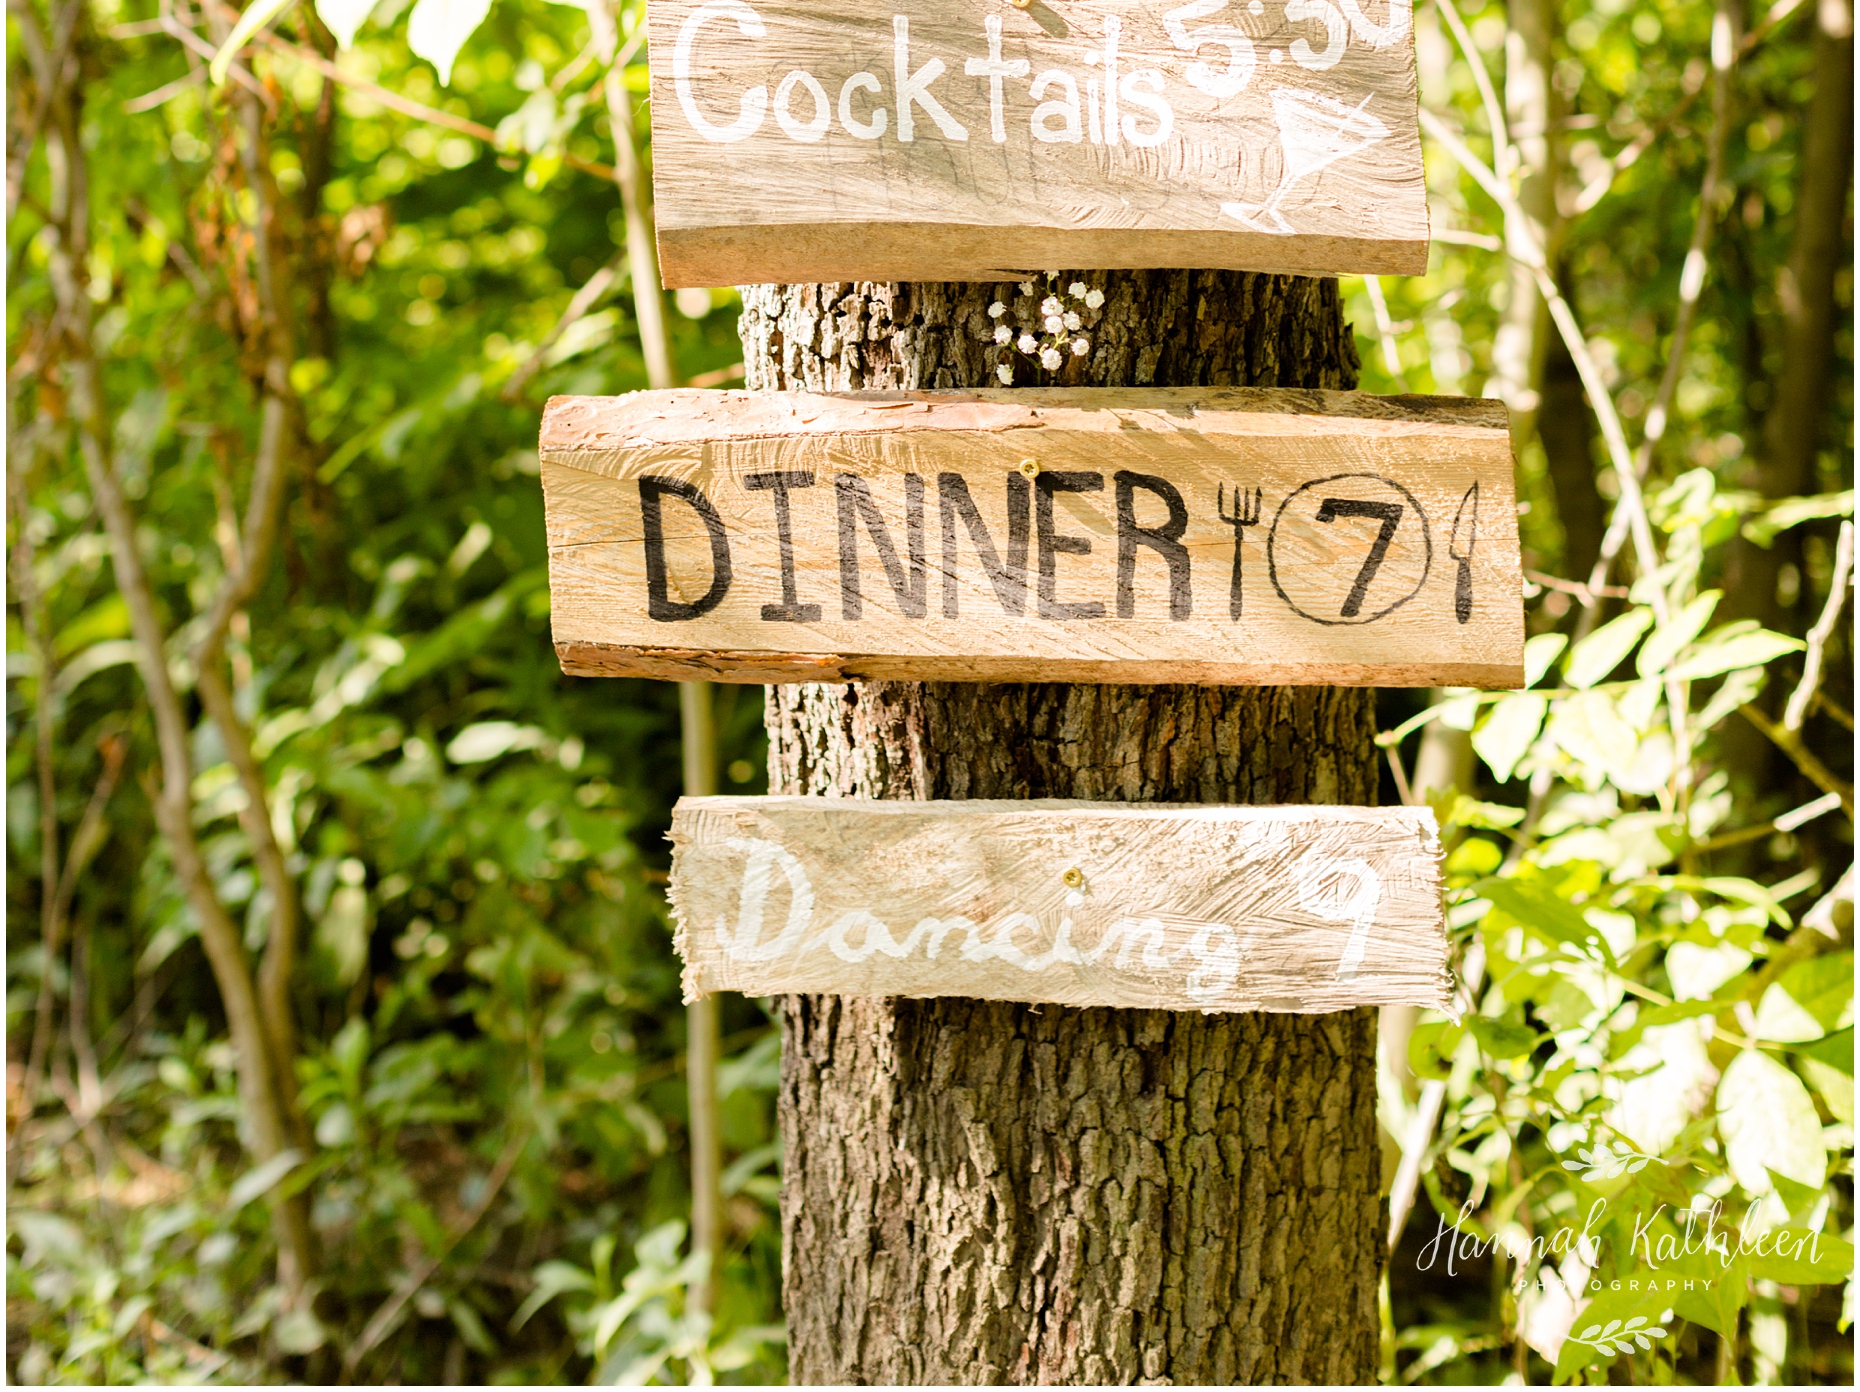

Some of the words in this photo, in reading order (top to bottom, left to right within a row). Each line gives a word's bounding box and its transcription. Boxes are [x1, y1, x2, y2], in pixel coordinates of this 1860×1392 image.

[637, 469, 1194, 623] DINNER
[1314, 497, 1405, 618] 7
[716, 837, 1241, 1004] Dancing
[1298, 857, 1384, 983] 9
